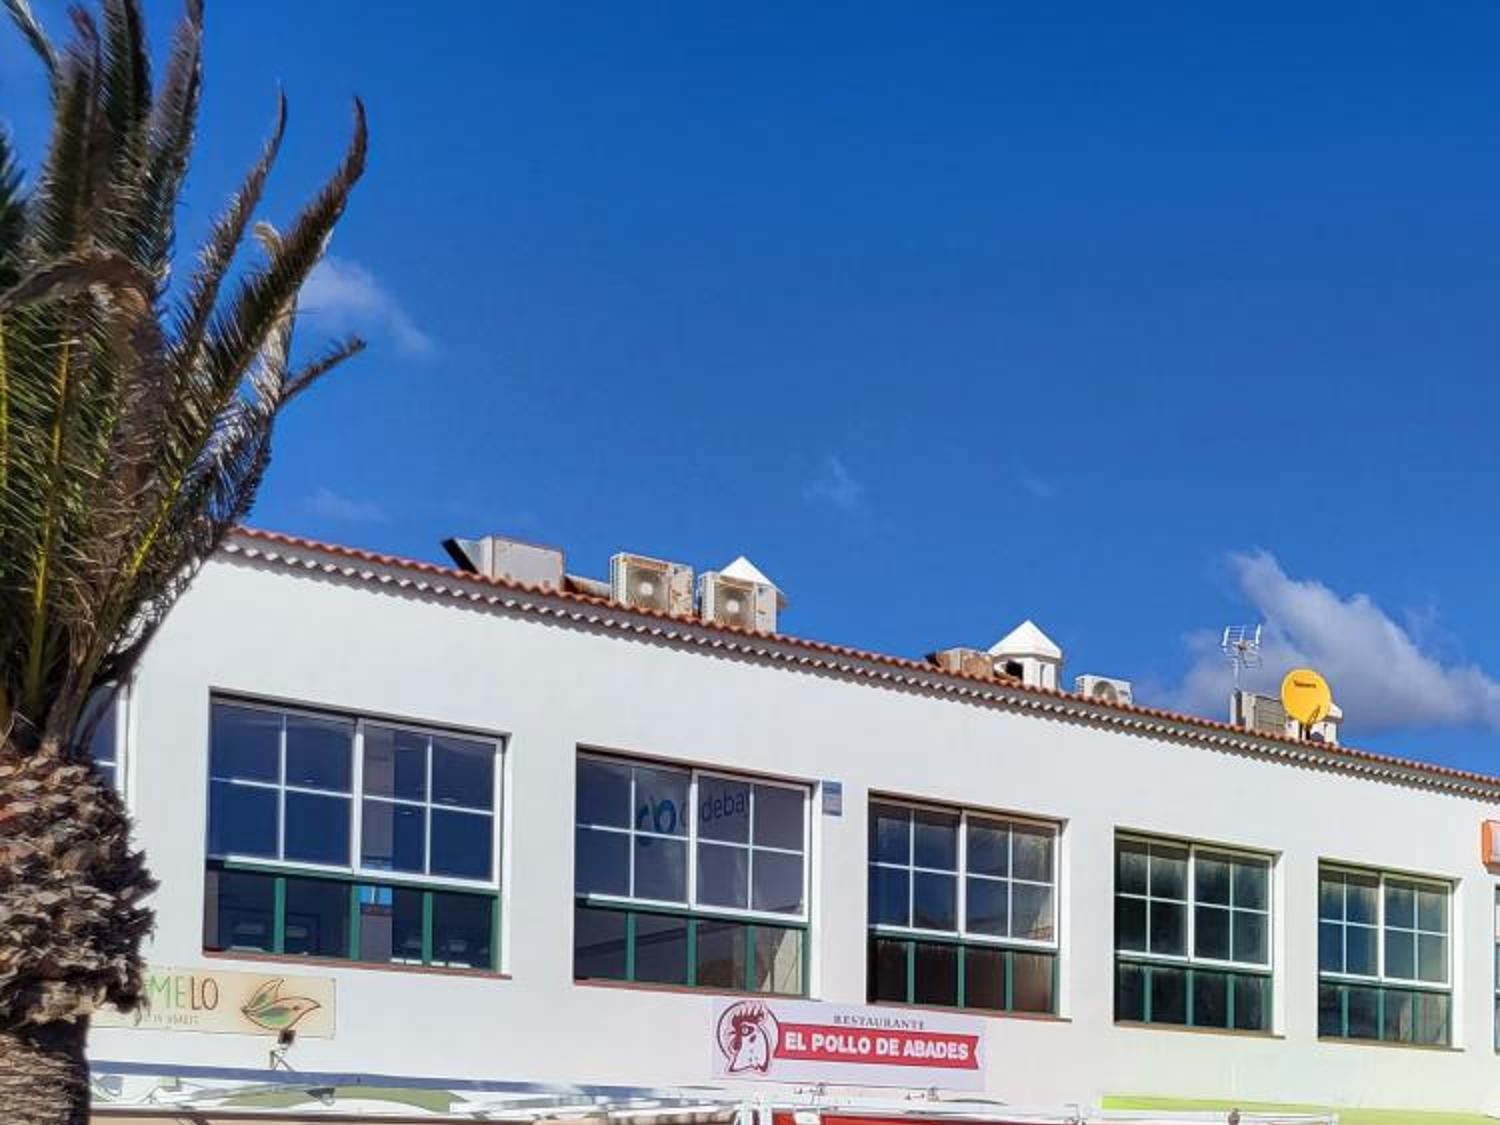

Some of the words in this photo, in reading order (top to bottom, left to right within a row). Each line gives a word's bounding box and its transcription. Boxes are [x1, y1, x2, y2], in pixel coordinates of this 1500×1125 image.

[833, 1014, 925, 1031] RESTAURANTE
[784, 1031, 807, 1052] EL
[811, 1033, 871, 1055] POLLO
[876, 1037, 899, 1057] DE
[903, 1040, 969, 1061] ABADES
